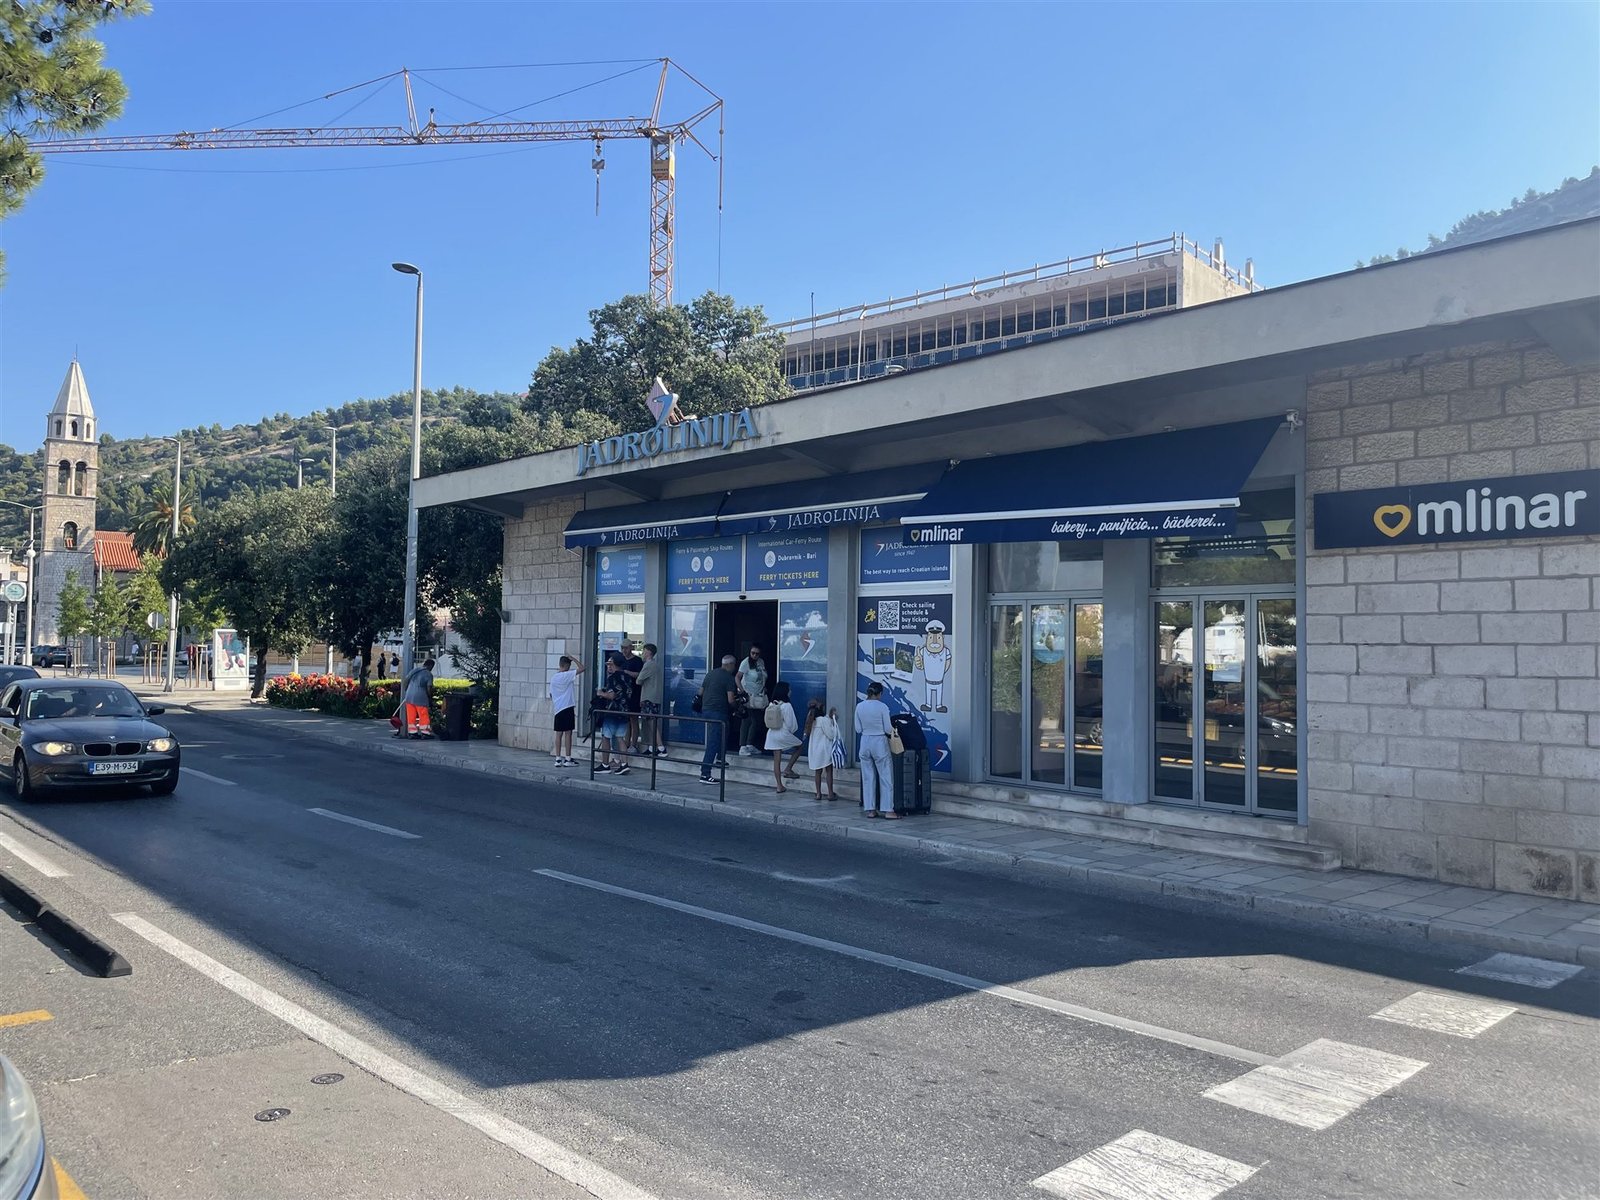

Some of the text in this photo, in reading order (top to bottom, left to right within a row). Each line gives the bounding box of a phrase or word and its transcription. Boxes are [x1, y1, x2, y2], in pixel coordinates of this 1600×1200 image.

[576, 407, 759, 476] JADROLINIJA
[787, 505, 880, 529] JADROLINIJA
[1417, 487, 1587, 536] mlinar
[613, 525, 679, 545] JADROLINIJA
[920, 525, 964, 542] mlinar
[777, 553, 802, 561] Dubrovnik
[778, 572, 802, 580] TICKETS
[803, 571, 819, 579] HERE
